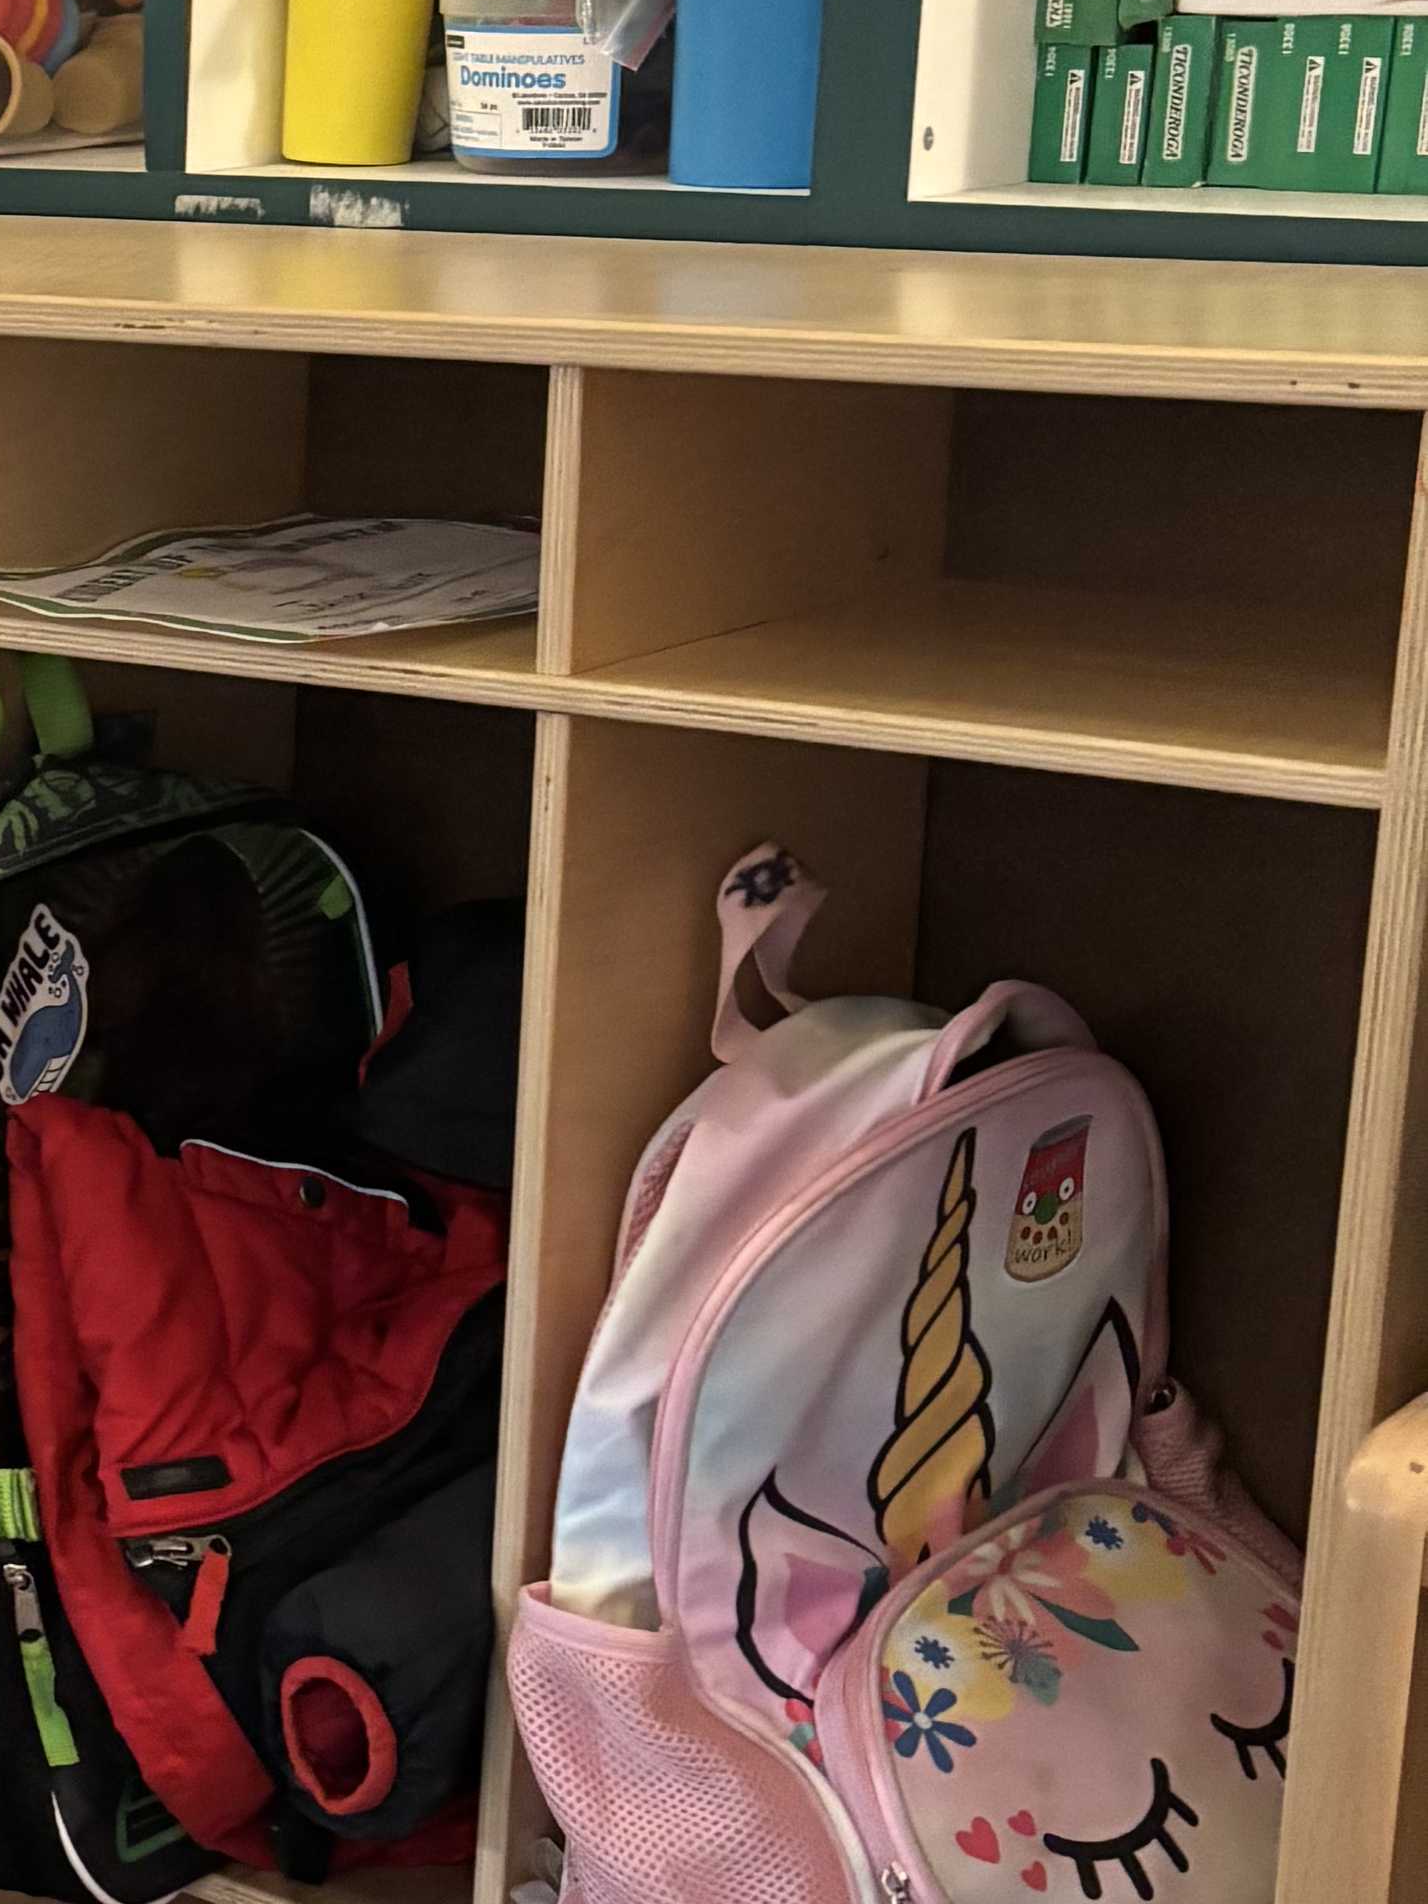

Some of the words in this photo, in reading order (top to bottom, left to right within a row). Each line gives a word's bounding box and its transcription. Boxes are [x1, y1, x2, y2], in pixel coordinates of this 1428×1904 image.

[460, 65, 566, 89] Dominoes
[1164, 46, 1188, 158] TICONDEROGA
[1230, 49, 1254, 158] TICONDEROGA
[0, 913, 60, 1027] WHALE
